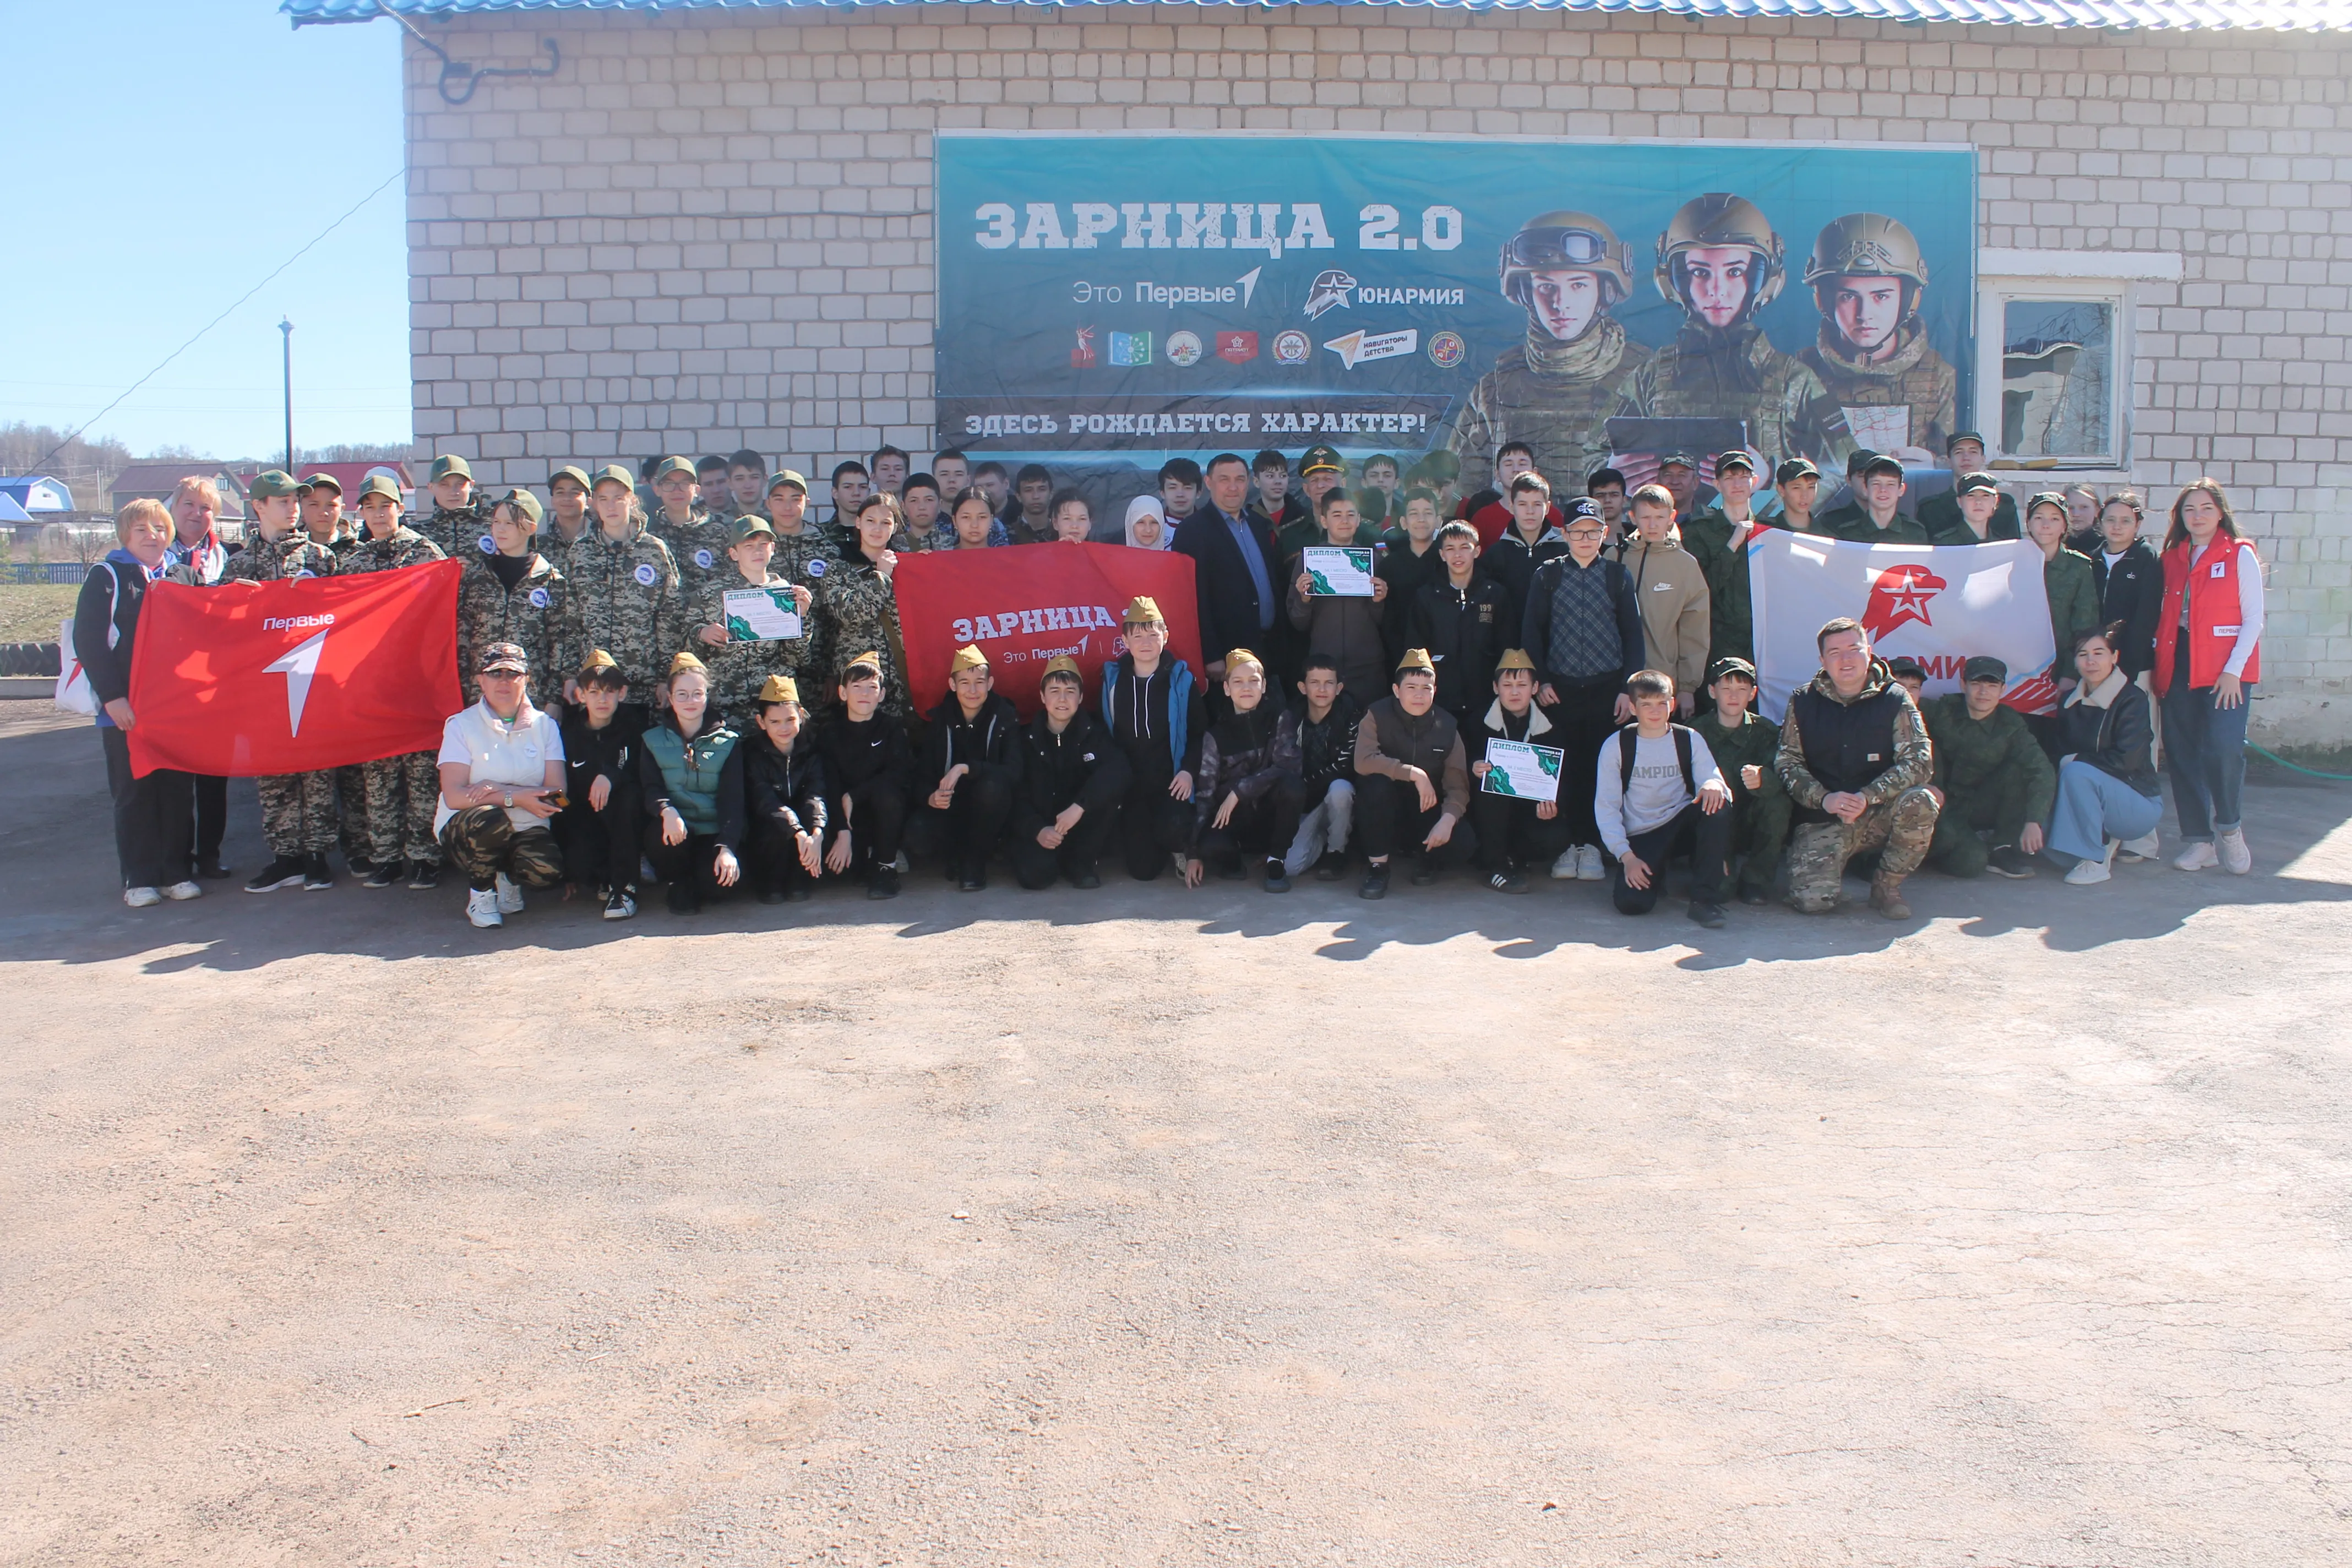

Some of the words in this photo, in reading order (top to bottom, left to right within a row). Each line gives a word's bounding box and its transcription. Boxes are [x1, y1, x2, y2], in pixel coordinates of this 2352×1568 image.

[975, 203, 1335, 259] ЗАРНИЦА
[1358, 204, 1463, 252] 2.0
[1073, 281, 1122, 303] Это
[1135, 282, 1237, 309] Первые
[1358, 286, 1464, 306] ЮНАРМИЯ
[1363, 336, 1408, 349] НАВИГАТОРЫ
[1364, 346, 1395, 357] ДЕТСТВА
[965, 415, 1058, 437] ЗДЕСЬ
[1069, 412, 1251, 435] РОЖДАЕТСЯ
[1261, 412, 1427, 434] ХАРАКТЕР!
[727, 591, 764, 601] ДИПЛОМ
[263, 613, 335, 633] Первые
[952, 606, 1117, 643] ЗАРНИЦА
[1003, 652, 1026, 663] Это
[1032, 646, 1079, 660] Первые
[1492, 742, 1530, 753] ДИПЛОМ
